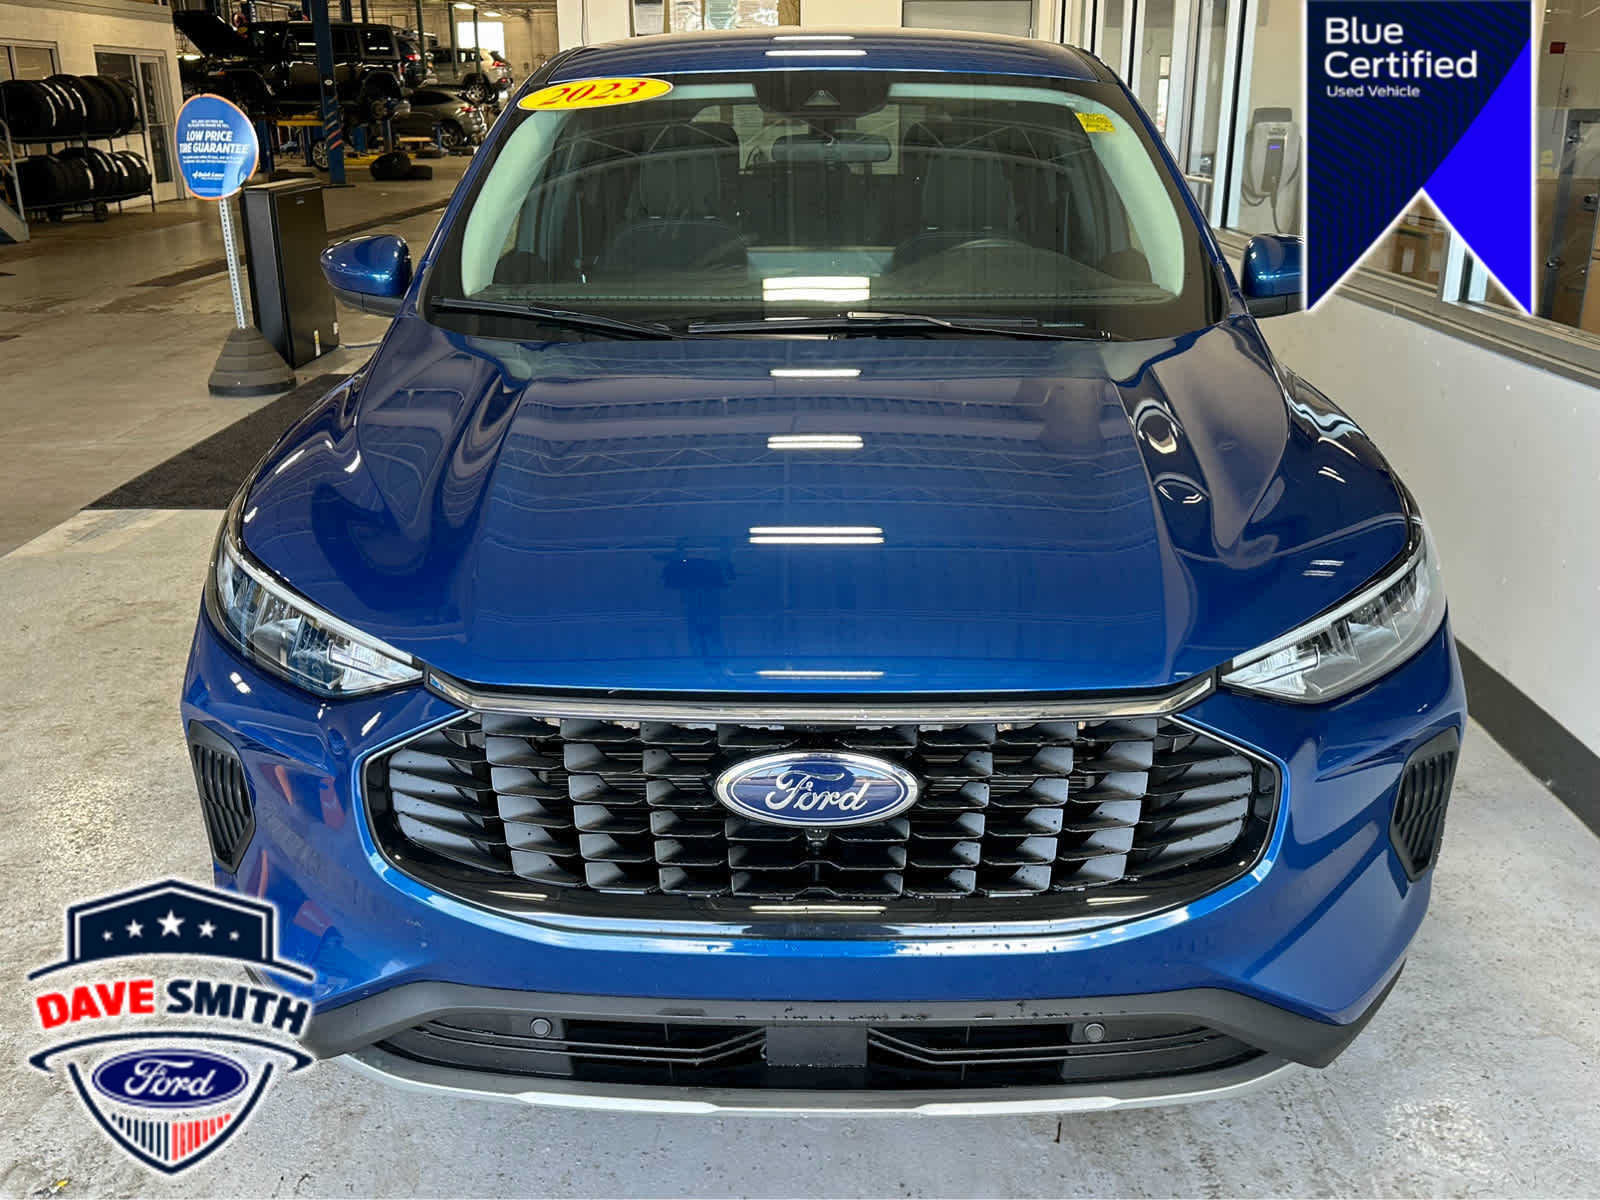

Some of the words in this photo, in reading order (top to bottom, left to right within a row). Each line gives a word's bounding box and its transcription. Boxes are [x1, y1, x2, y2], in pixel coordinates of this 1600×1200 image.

[538, 81, 647, 106] 2023
[186, 130, 204, 142] LOW
[205, 130, 233, 142] PRICE
[193, 143, 249, 154] GUARANTEE
[764, 769, 870, 812] Ford
